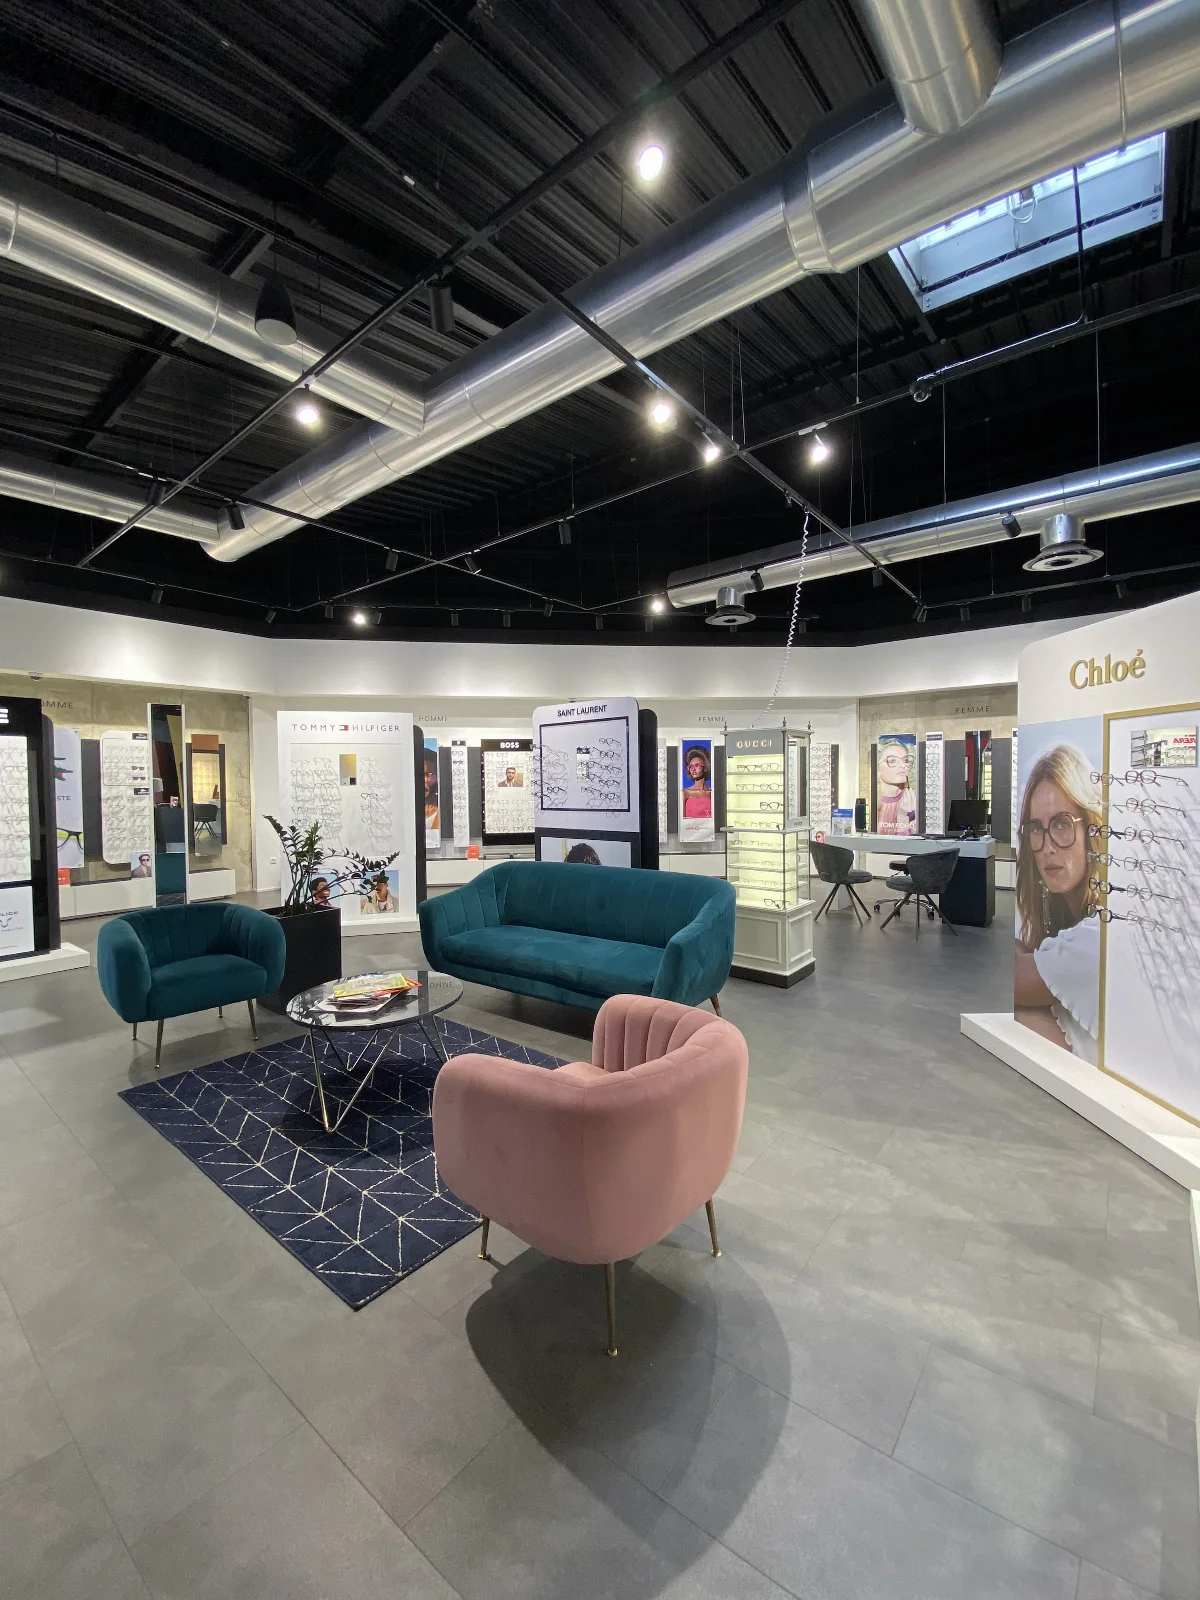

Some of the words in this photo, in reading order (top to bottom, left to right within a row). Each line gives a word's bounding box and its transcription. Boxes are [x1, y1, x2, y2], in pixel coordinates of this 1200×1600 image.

[1069, 649, 1146, 689] Chloé
[41, 701, 73, 709] MME
[557, 708, 575, 716] SAINT
[576, 704, 607, 715] LAURENT
[955, 706, 990, 714] FEMME
[291, 723, 336, 731] TOMMY
[352, 724, 400, 732] HILFIGER
[500, 741, 520, 749] BOSS
[736, 739, 772, 749] GUCCI
